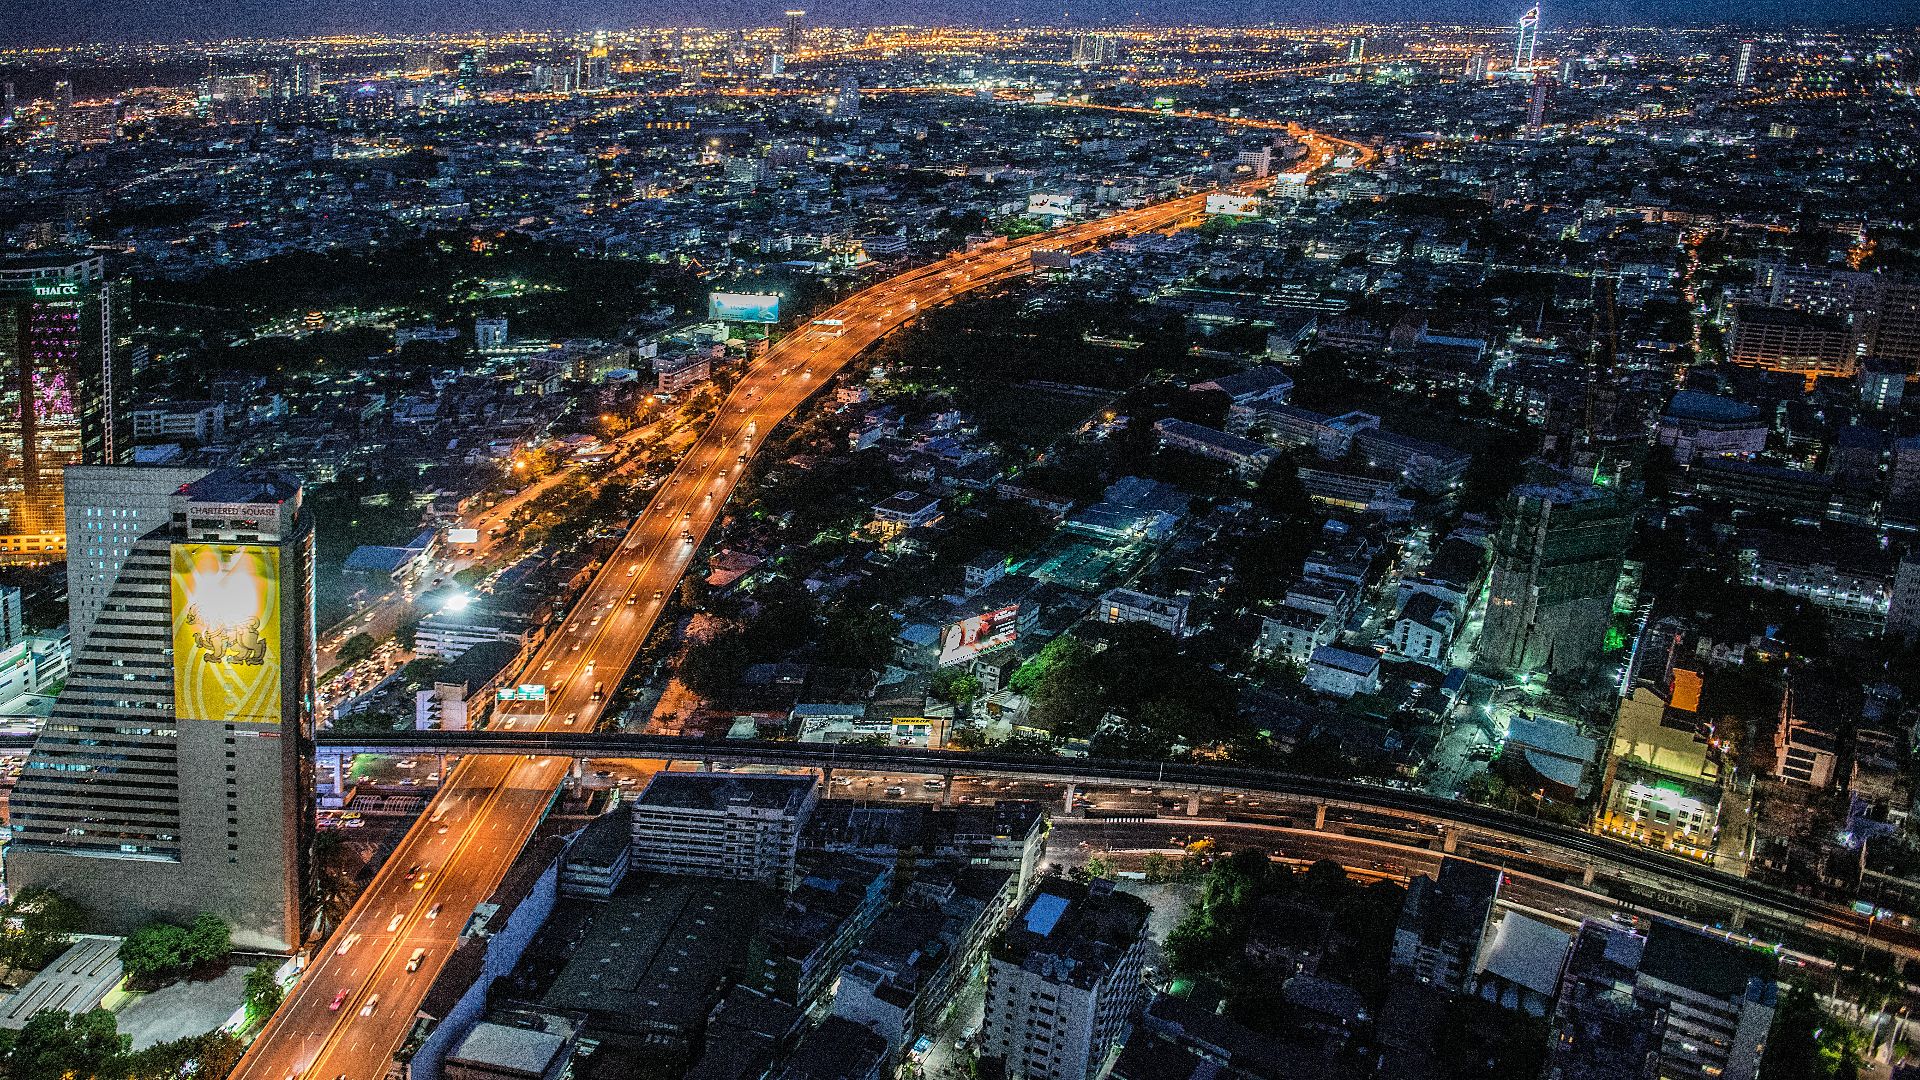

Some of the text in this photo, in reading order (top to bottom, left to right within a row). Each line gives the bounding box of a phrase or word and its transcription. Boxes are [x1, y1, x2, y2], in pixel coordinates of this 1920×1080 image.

[35, 286, 78, 295] THAI CC
[190, 506, 238, 515] CHARTERED
[242, 508, 276, 516] SQUARE
